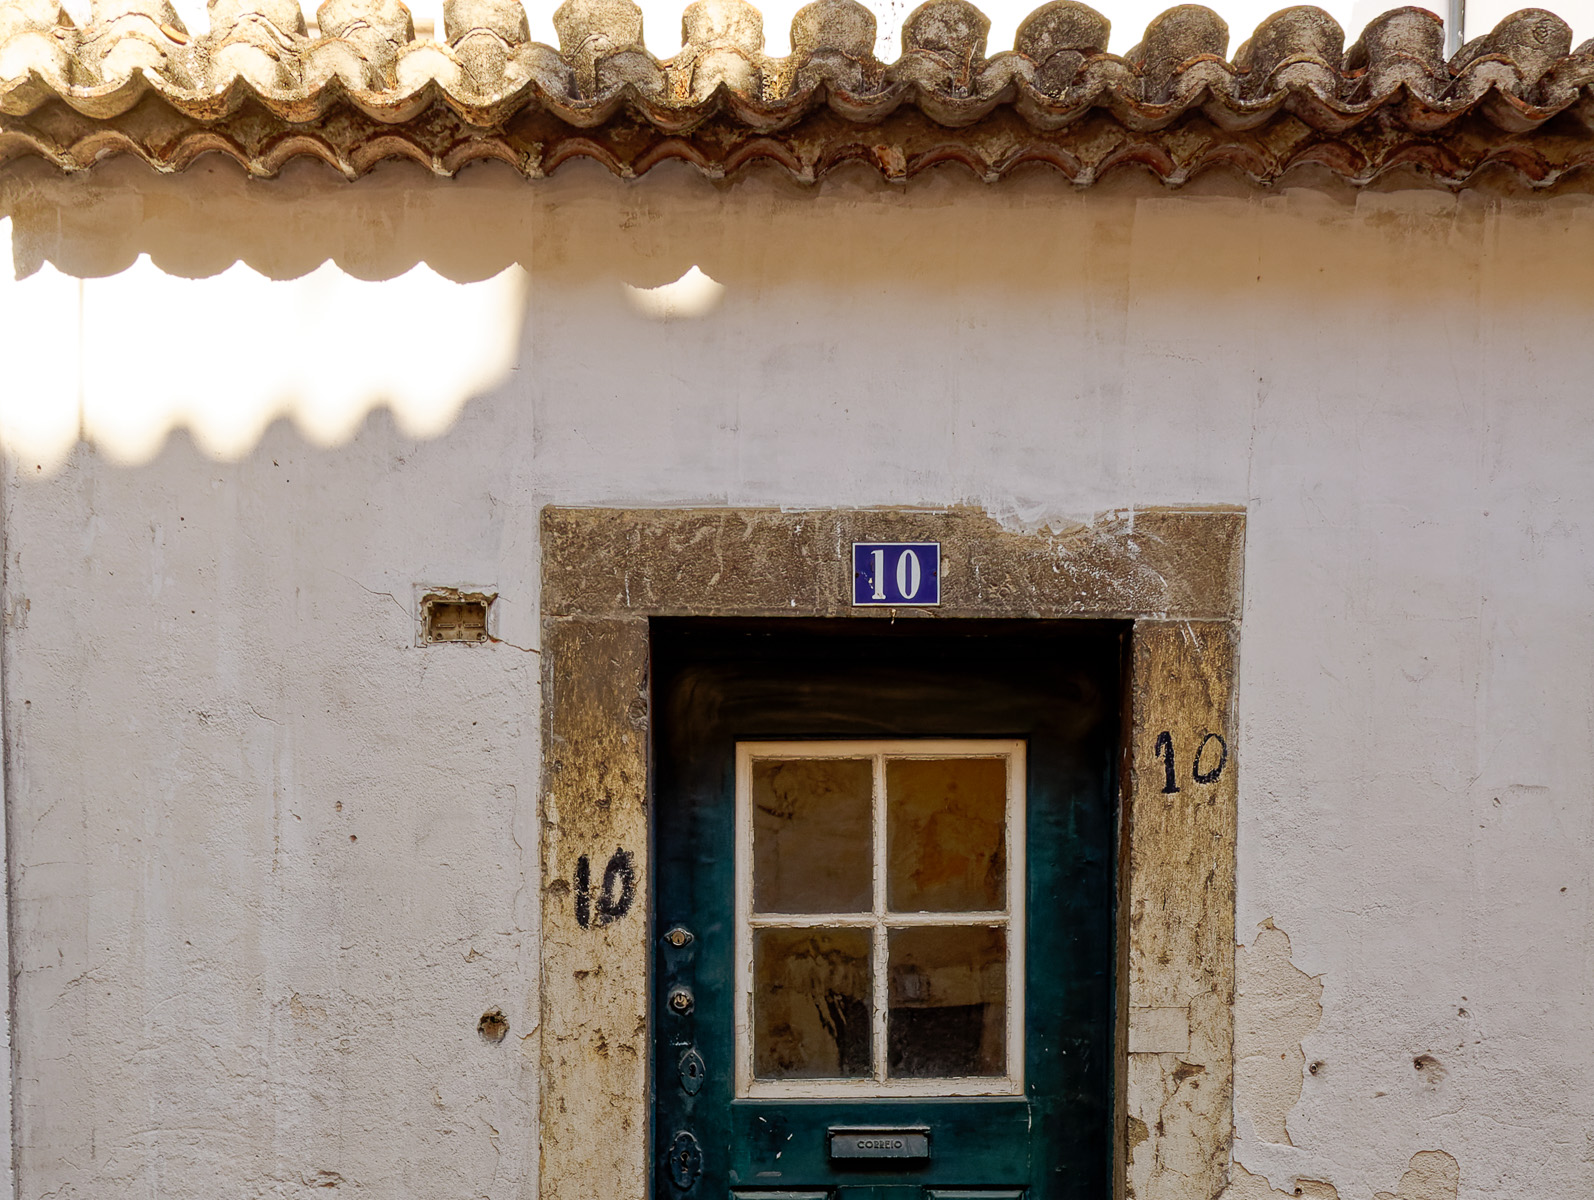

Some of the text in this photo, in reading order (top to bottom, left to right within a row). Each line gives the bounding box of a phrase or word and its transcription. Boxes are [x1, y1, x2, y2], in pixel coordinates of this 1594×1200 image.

[870, 549, 921, 600] 10
[1154, 731, 1227, 794] 10
[573, 847, 634, 930] 10
[857, 1140, 902, 1149] CORREIO
